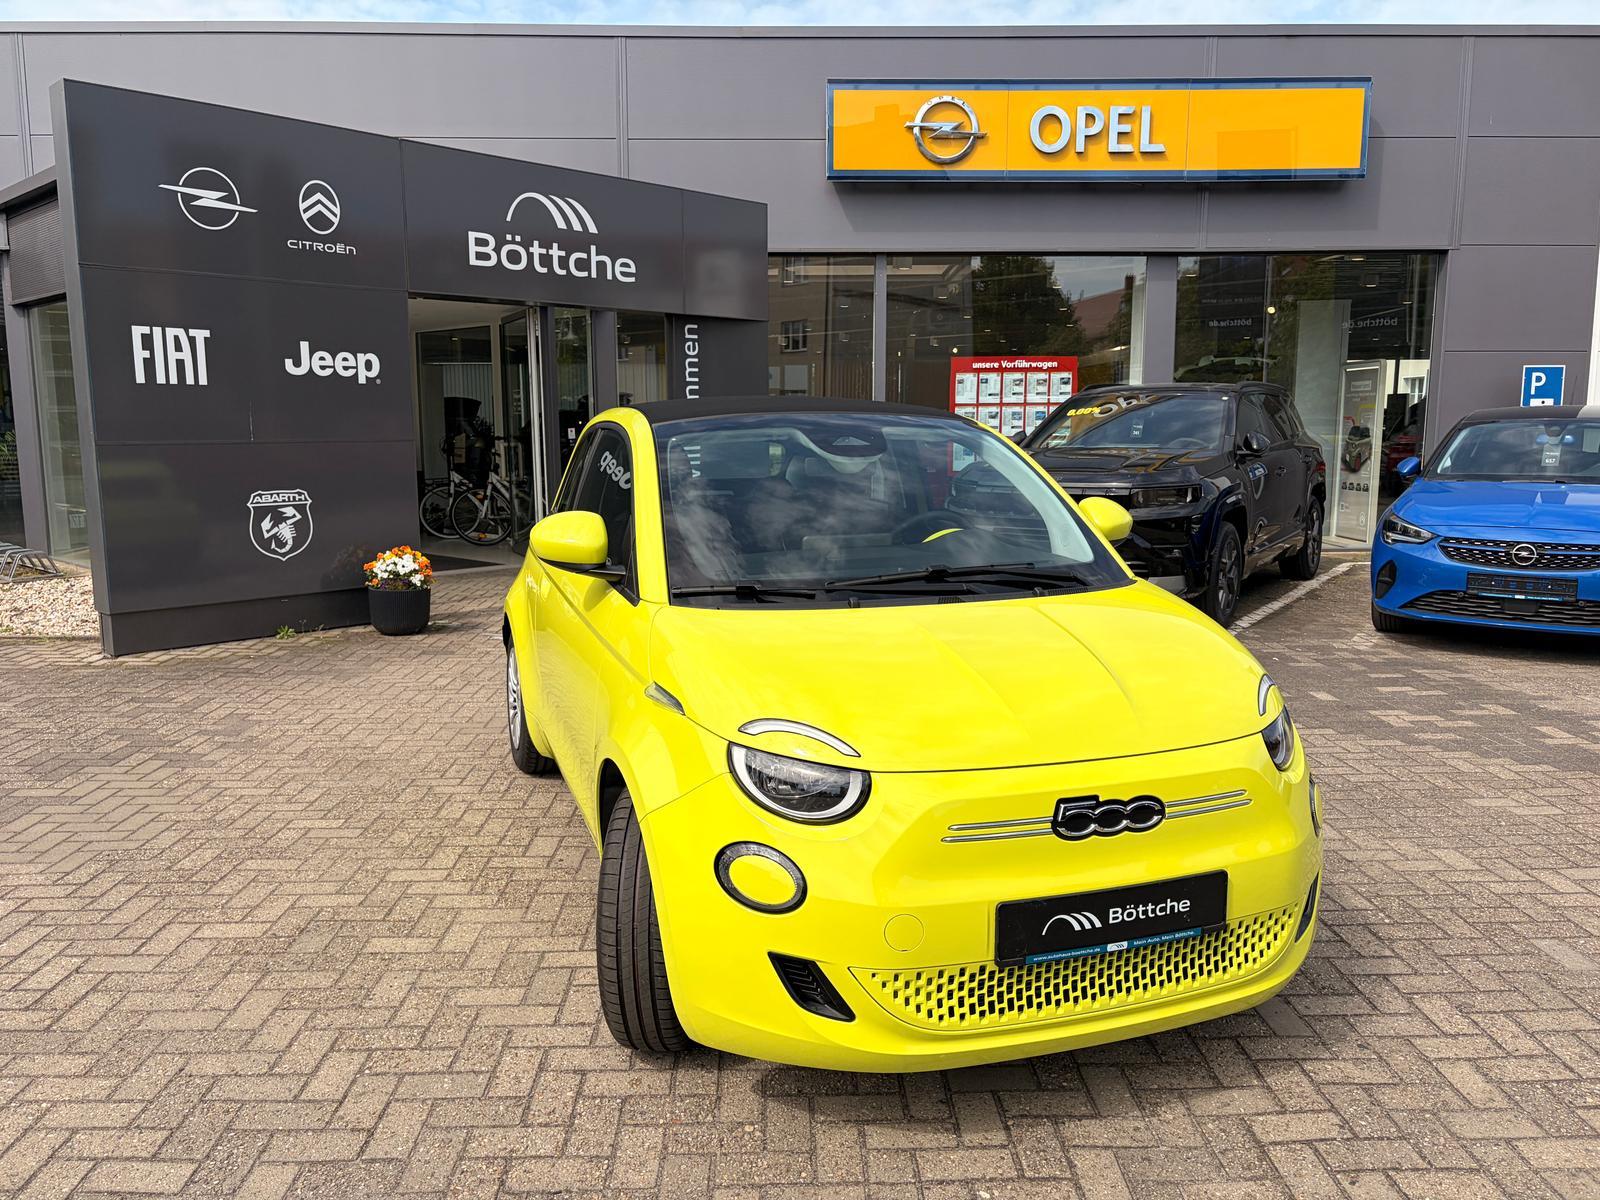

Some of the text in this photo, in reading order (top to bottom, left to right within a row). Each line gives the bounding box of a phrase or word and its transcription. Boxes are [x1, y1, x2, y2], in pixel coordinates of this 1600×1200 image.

[1029, 105, 1167, 154] OPEL
[467, 230, 637, 283] Böttche
[131, 325, 211, 386] FIAT
[284, 340, 381, 385] Jeep
[1001, 360, 1058, 370] Vorführwagen
[1530, 371, 1547, 395] P
[253, 493, 305, 503] ABARTH
[1055, 796, 1165, 838] 500
[1109, 898, 1191, 924] Böttche
